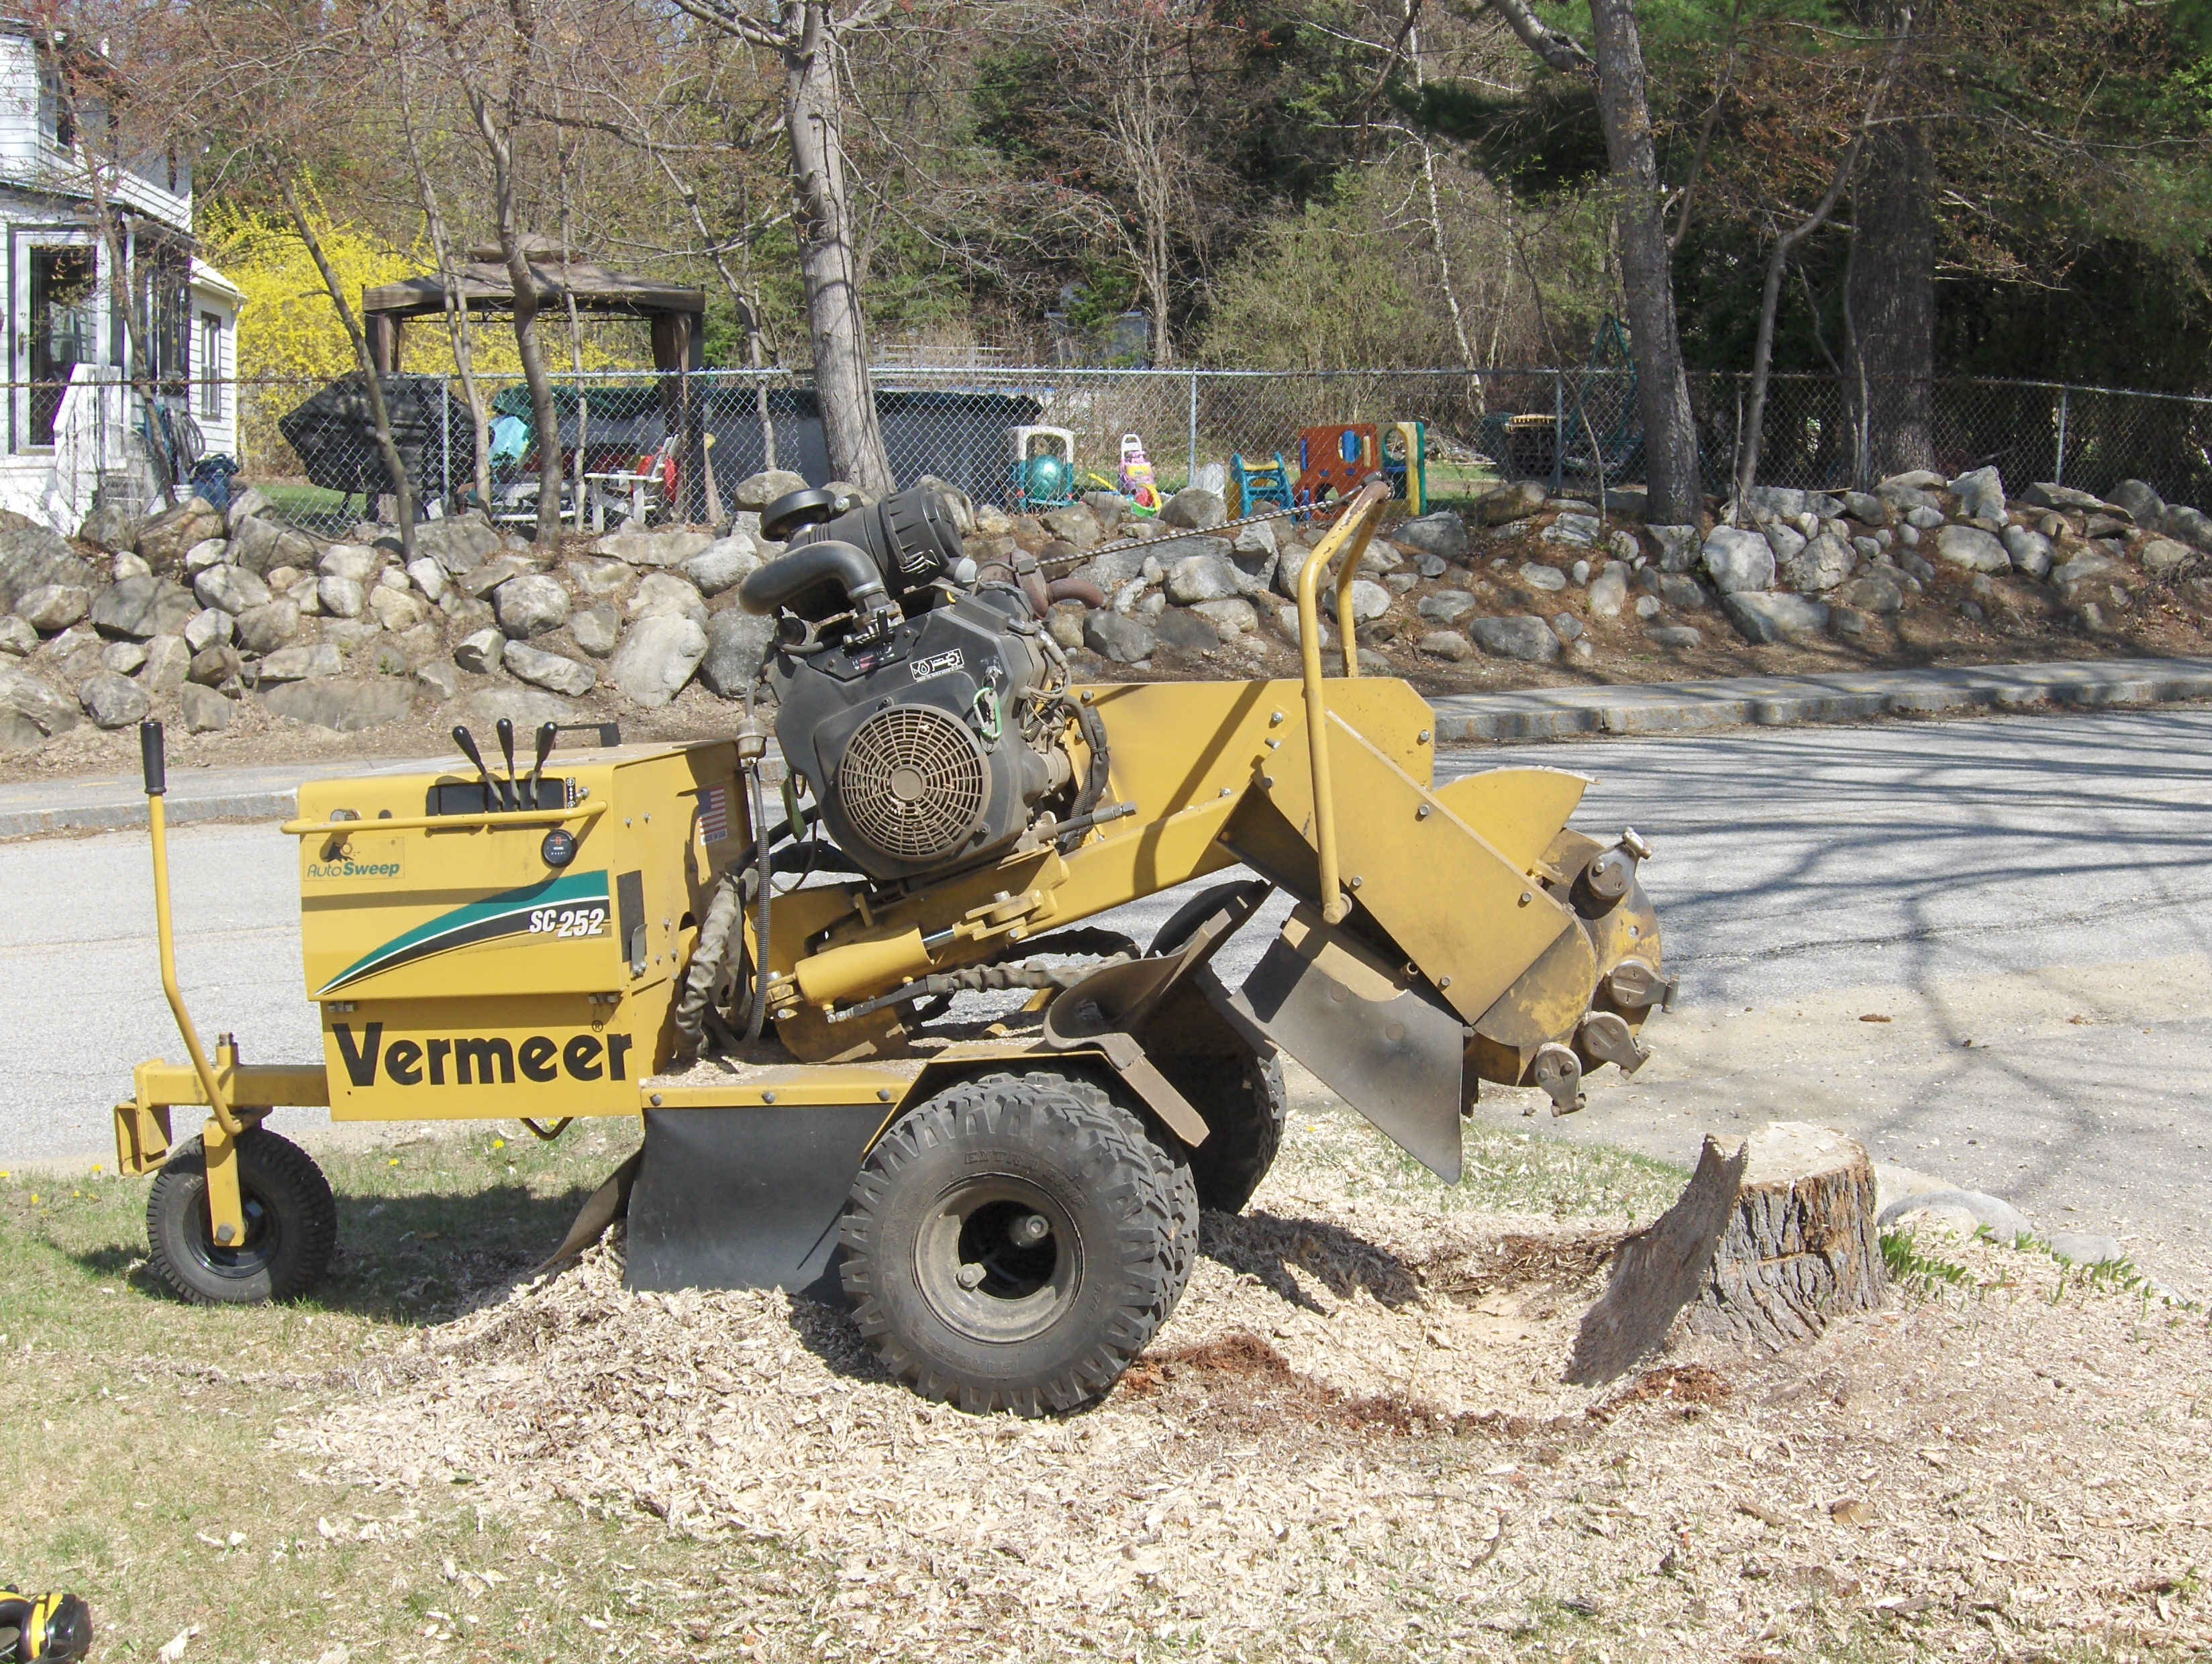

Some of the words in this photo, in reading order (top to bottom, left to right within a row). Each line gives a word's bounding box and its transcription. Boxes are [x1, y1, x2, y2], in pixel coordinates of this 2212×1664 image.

[332, 1022, 632, 1086] Vermeer
[965, 1149, 1038, 1171] EXTRA
[1043, 1167, 1088, 1208] GRIP
